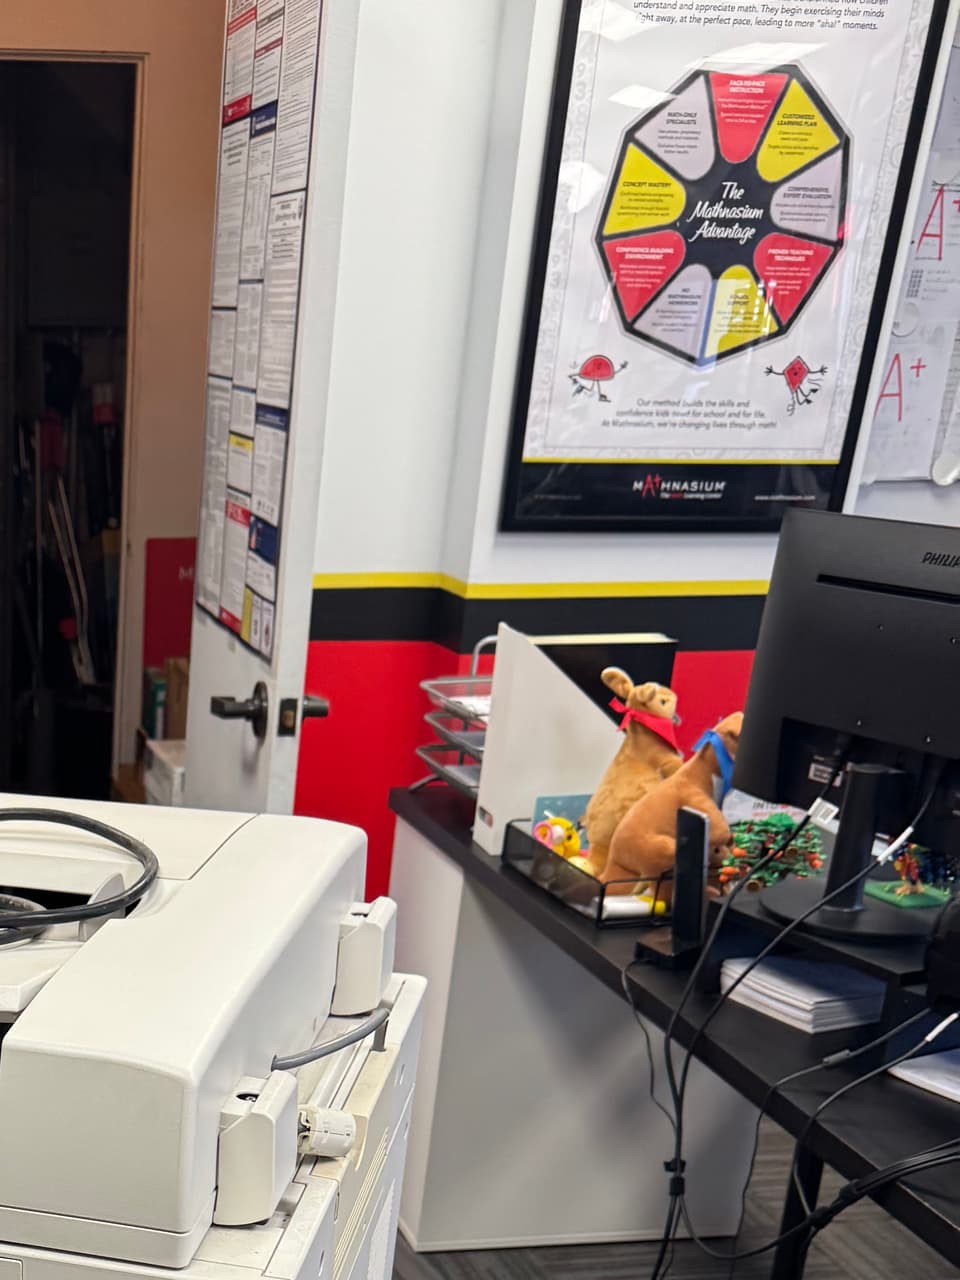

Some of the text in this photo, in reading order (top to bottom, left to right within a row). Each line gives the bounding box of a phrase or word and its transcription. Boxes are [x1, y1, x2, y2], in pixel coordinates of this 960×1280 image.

[633, 0, 678, 9] understand
[679, 1, 694, 10] and
[694, 2, 736, 15] appreciate
[736, 3, 758, 13] math.
[762, 4, 779, 16] They
[780, 5, 802, 17] begin
[844, 7, 862, 17] their
[862, 8, 885, 18] minds
[656, 15, 678, 25] away,
[679, 14, 688, 22] at
[690, 14, 702, 23] the
[704, 15, 731, 27] perfect
[732, 18, 754, 28] pace,
[754, 17, 783, 29] leading
[784, 18, 793, 26] to
[842, 20, 878, 30] moments.
[722, 182, 745, 200] The
[686, 200, 764, 222] Mathnasium
[688, 220, 756, 245] Advantage
[874, 352, 927, 422] A+
[637, 398, 651, 406] Our
[652, 399, 680, 407] method
[705, 400, 716, 408] the
[718, 400, 735, 408] skills
[736, 400, 750, 408] and
[704, 410, 726, 418] school
[728, 410, 741, 418] and
[742, 410, 752, 418] for
[679, 420, 710, 430] changing
[712, 420, 727, 428] lives
[729, 420, 756, 430] through
